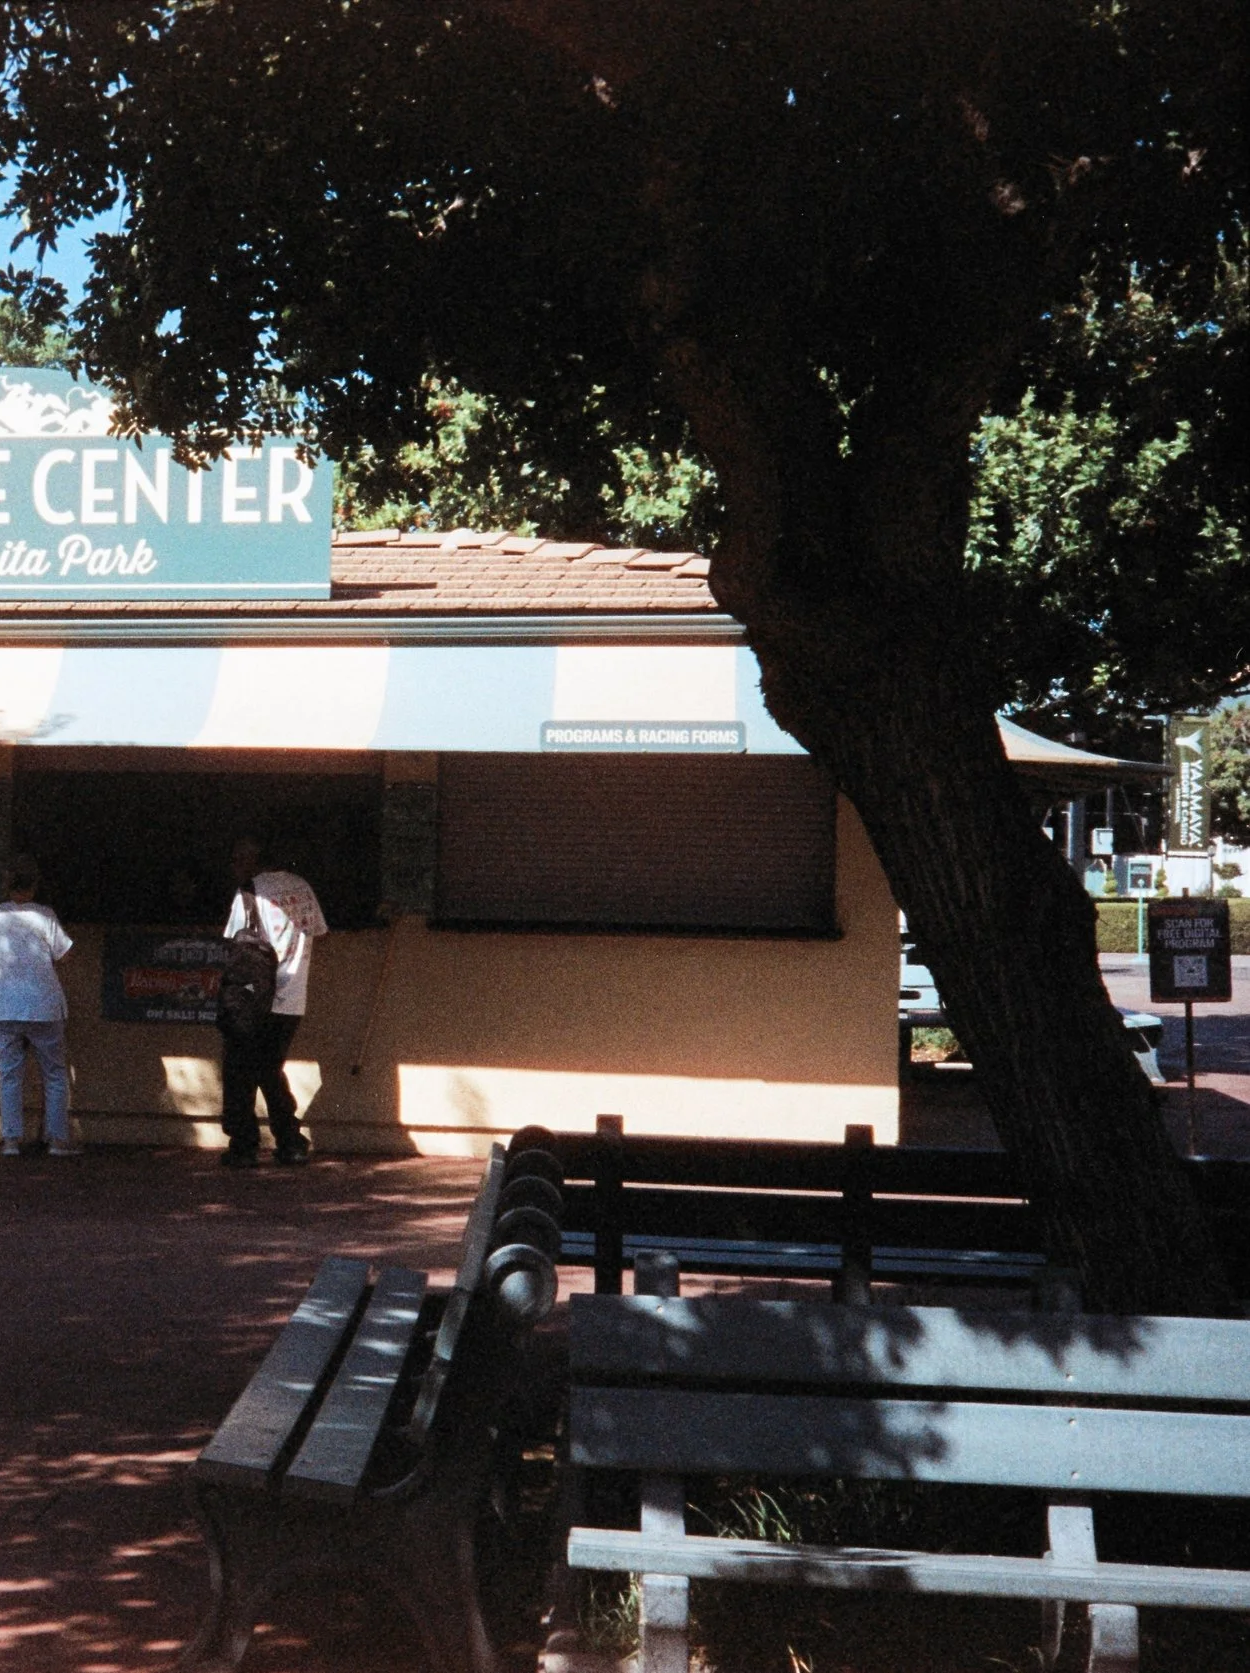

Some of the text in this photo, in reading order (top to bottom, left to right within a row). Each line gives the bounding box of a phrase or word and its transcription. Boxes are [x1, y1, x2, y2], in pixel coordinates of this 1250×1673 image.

[58, 533, 158, 577] Park
[546, 729, 739, 744] PROGRAMS & RACING FORMS
[1180, 810, 1188, 845] CASINO
[1164, 918, 1215, 929] SCAN FOR
[1157, 928, 1223, 939] FREE DIGITAL
[1164, 938, 1215, 949] PROGRAM
[166, 1009, 196, 1020] SALE
